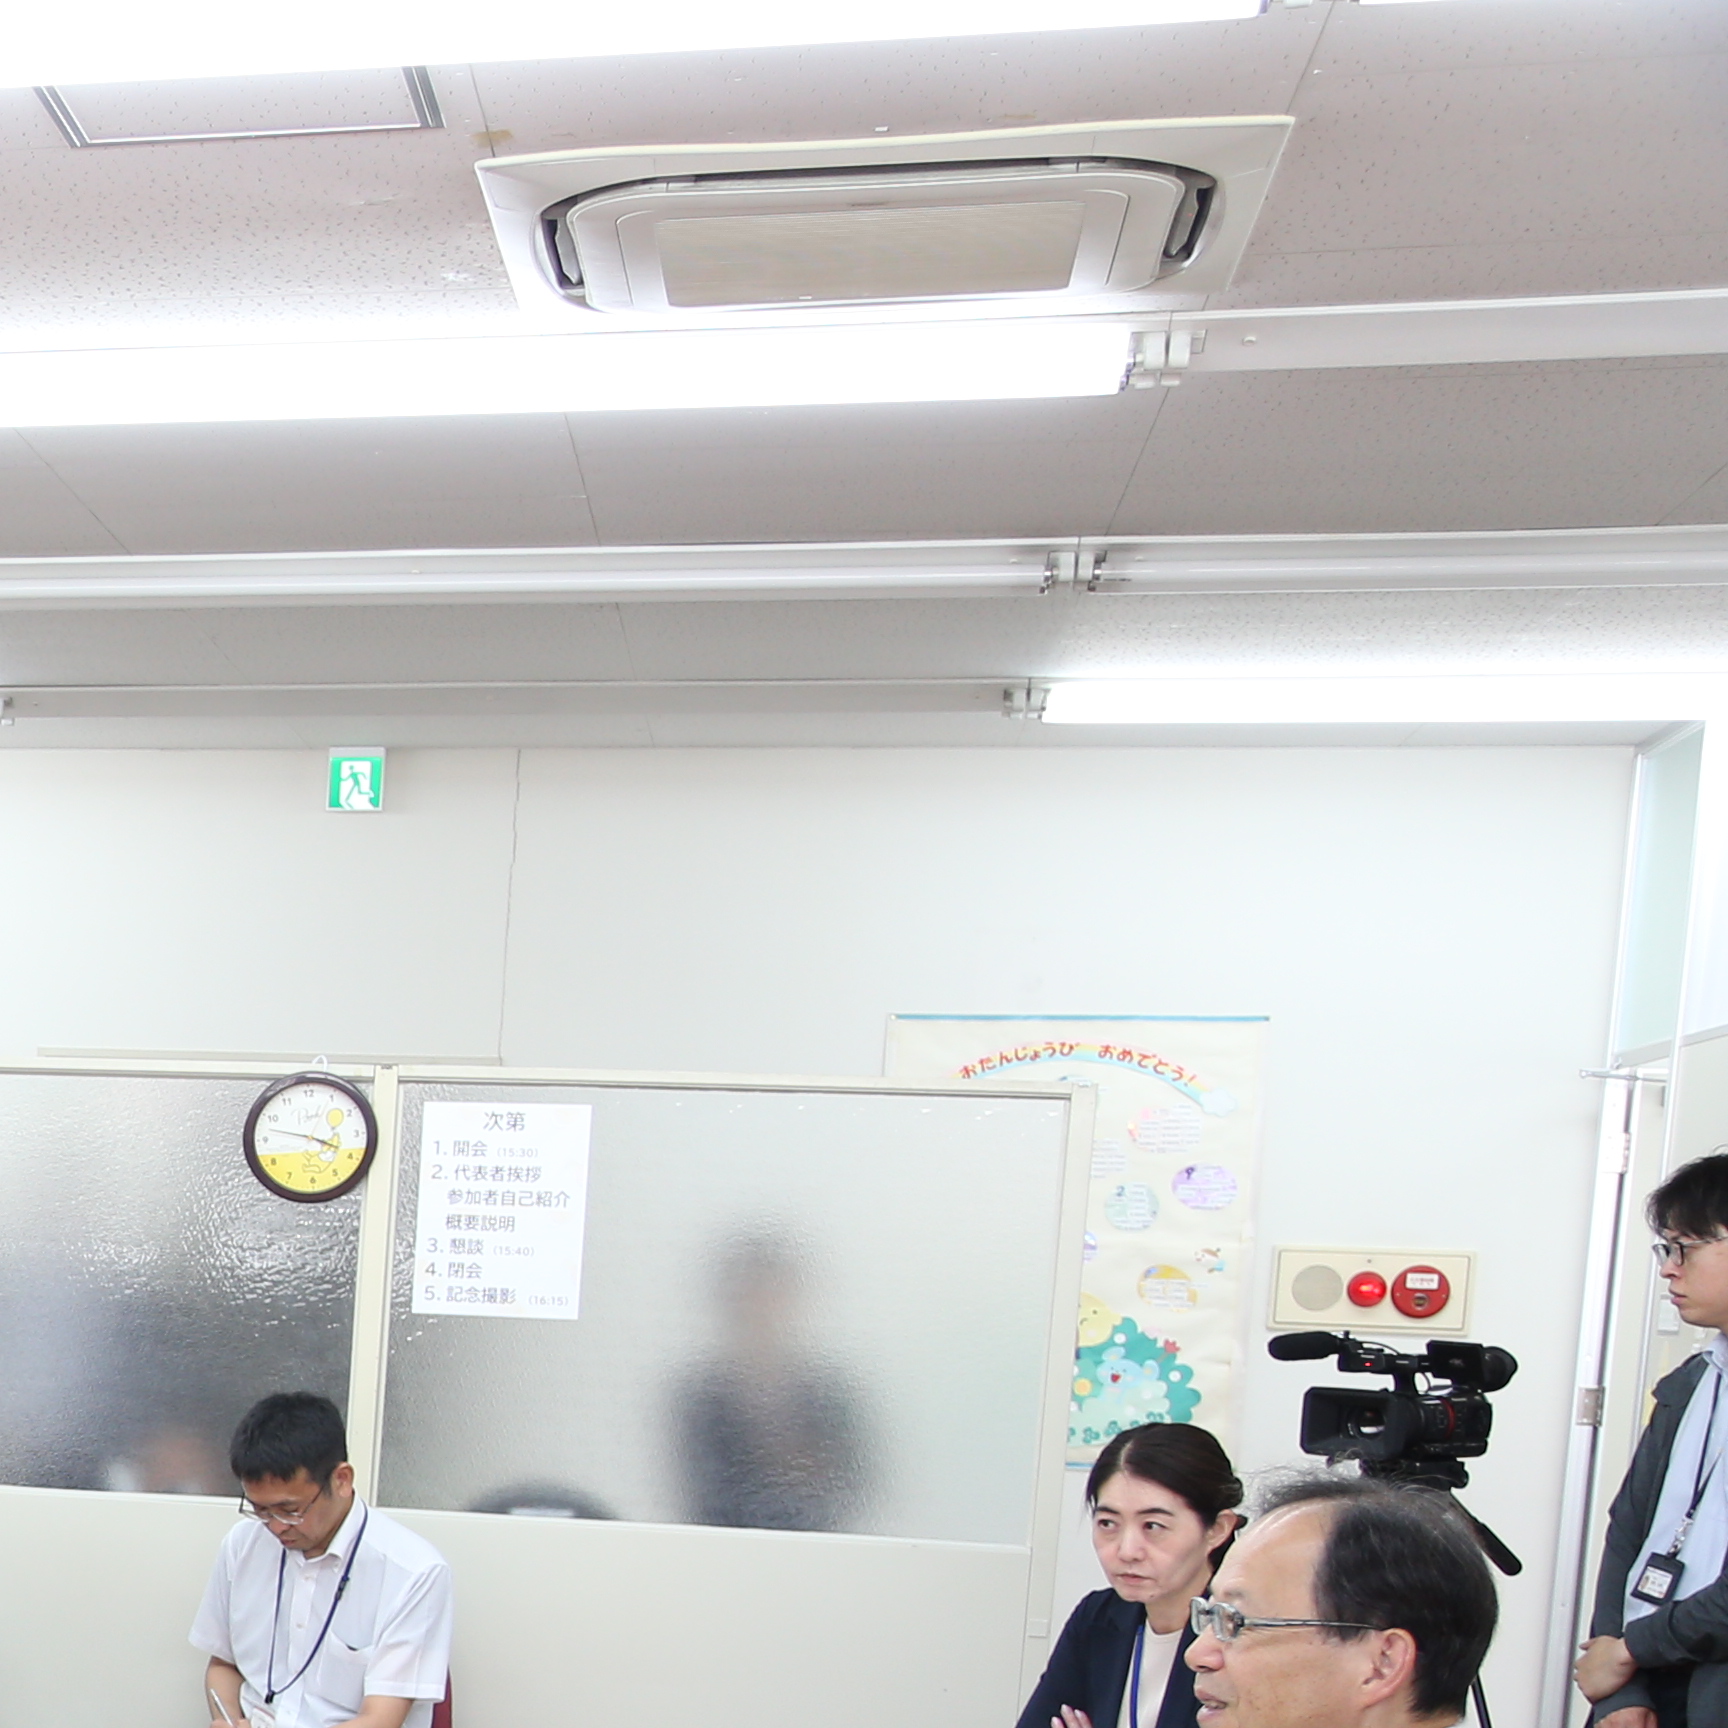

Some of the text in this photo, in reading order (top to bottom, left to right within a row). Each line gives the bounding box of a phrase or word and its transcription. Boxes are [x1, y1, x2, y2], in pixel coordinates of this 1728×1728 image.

[959, 1041, 1080, 1079] おたんじょうび
[482, 1111, 526, 1132] 次第
[452, 1141, 488, 1157] 開会
[454, 1165, 542, 1183] 代表者挨拶
[447, 1189, 571, 1208] 参加者自己紹介
[445, 1214, 516, 1233] 概要説明
[449, 1238, 484, 1256] 懇談
[447, 1262, 482, 1279] 閉会
[446, 1287, 517, 1305] 記念撮影
